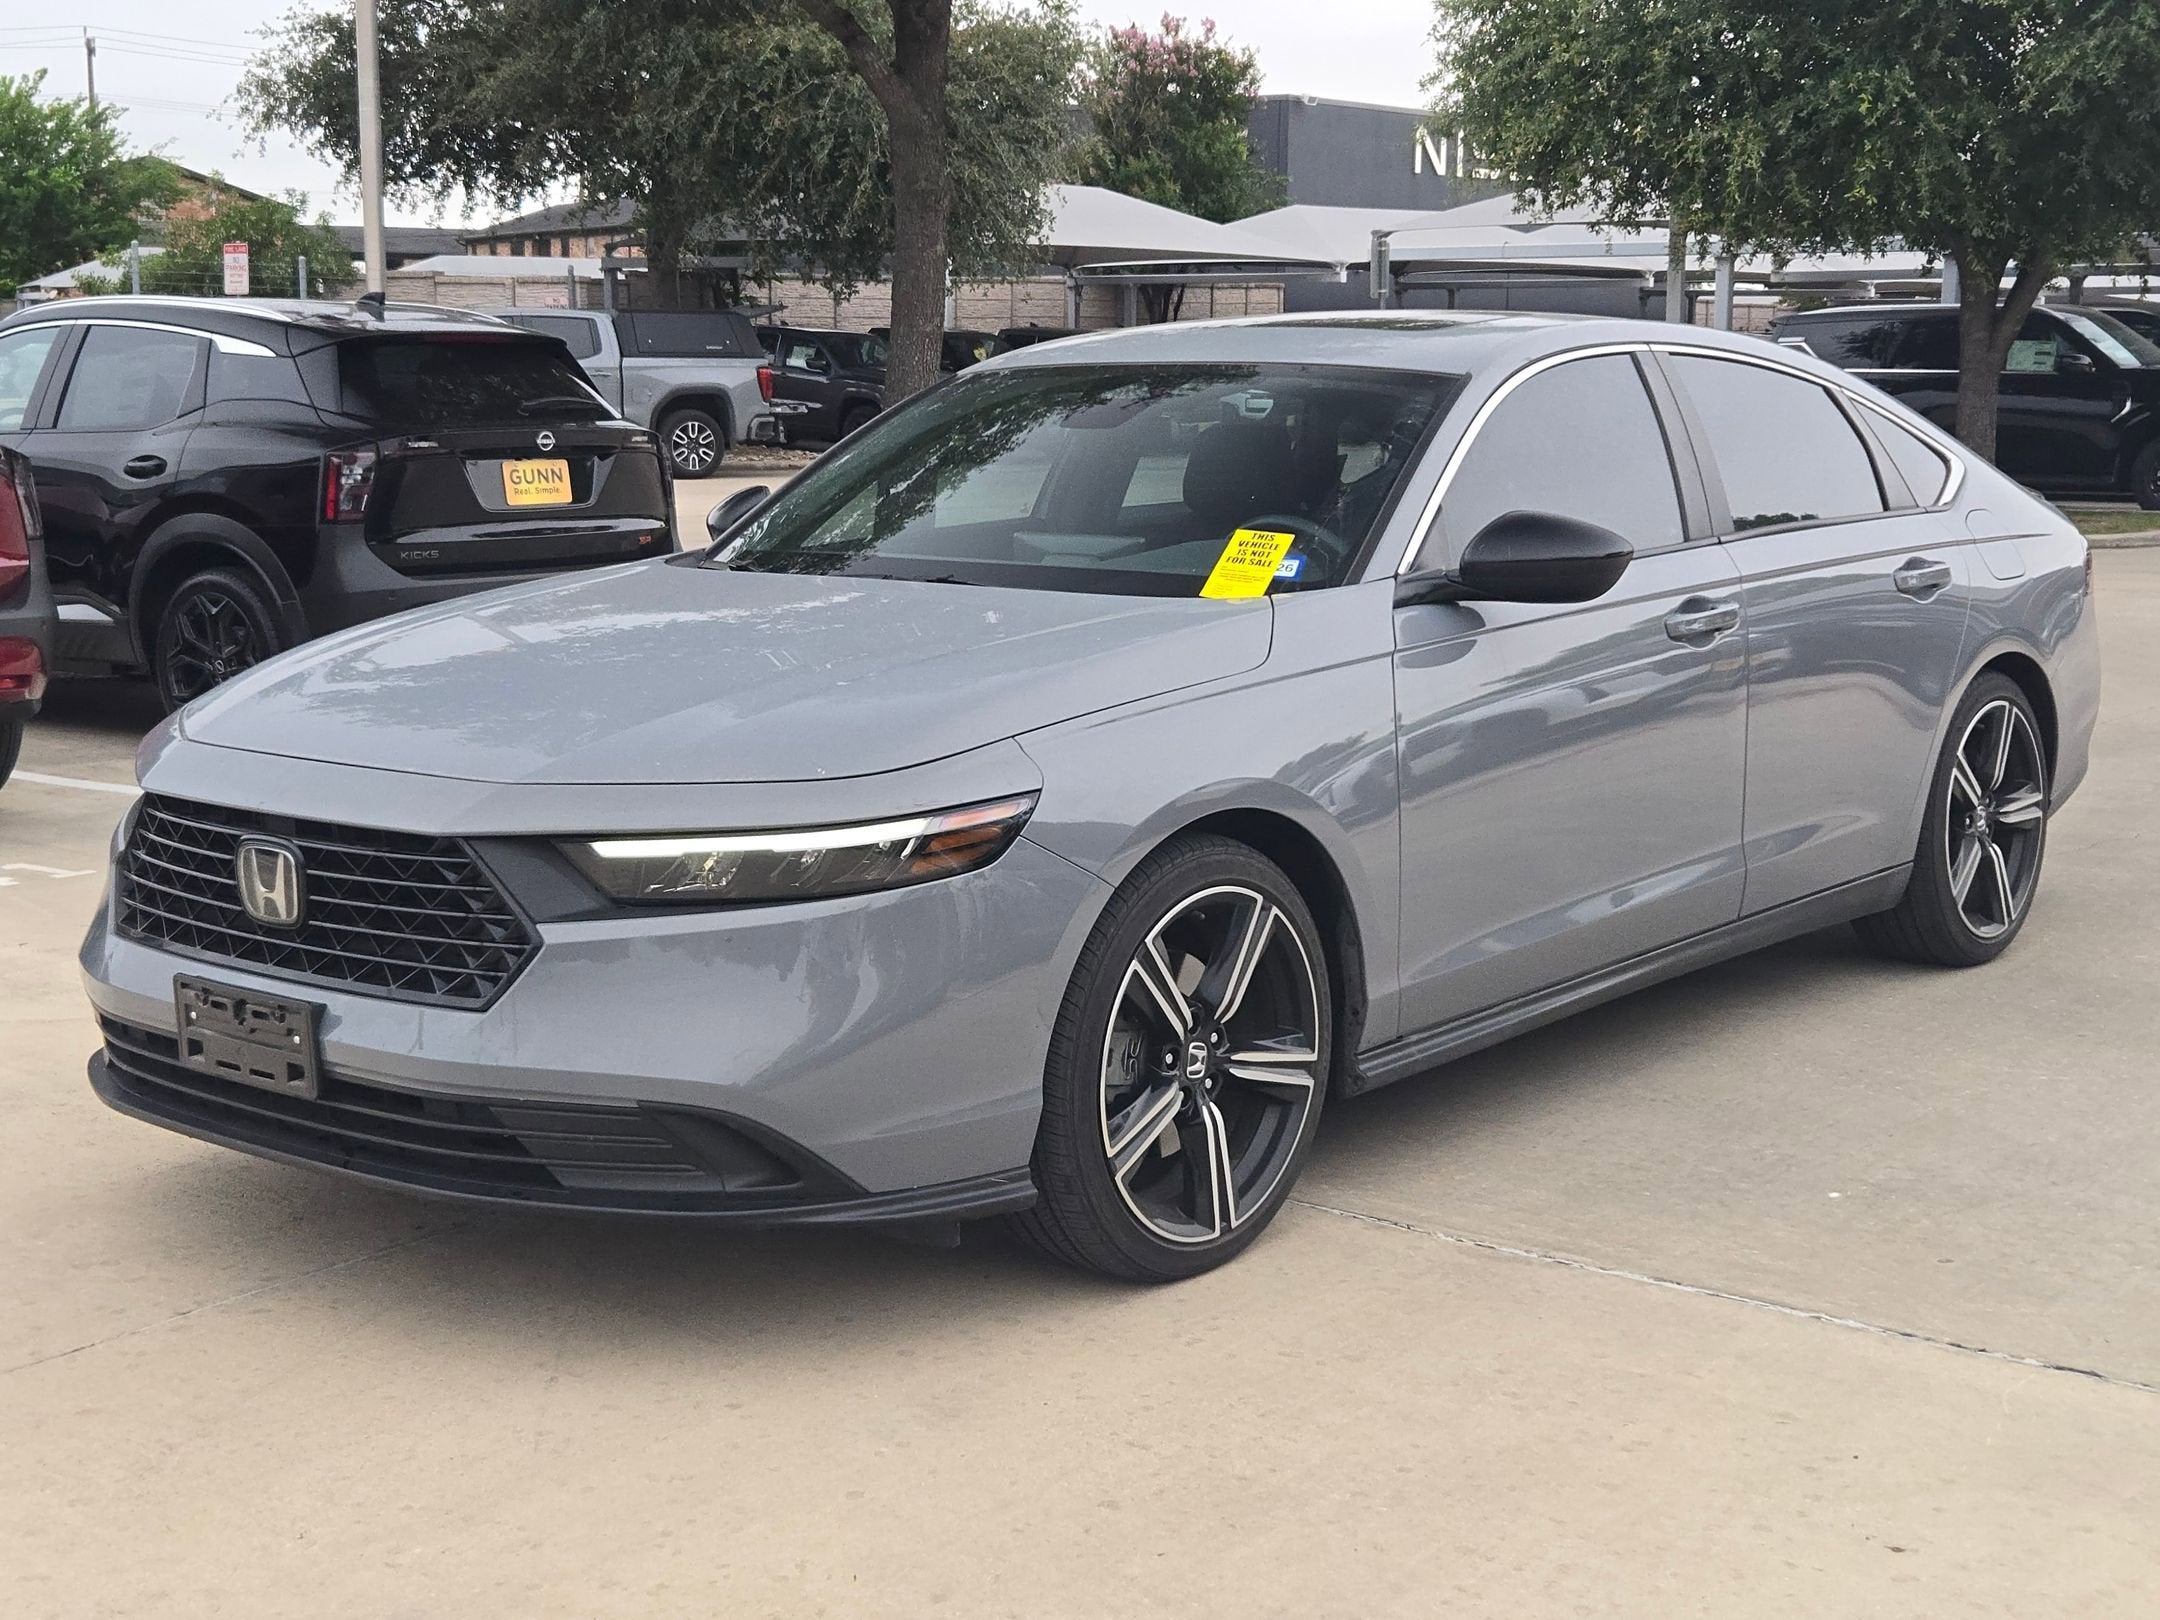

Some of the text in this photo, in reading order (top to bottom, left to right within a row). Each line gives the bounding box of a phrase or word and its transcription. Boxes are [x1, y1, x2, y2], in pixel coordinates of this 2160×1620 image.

[509, 467, 563, 485] GUNN
[513, 486, 562, 496] Real. Simple.
[1251, 532, 1276, 541] THIS
[1238, 540, 1281, 551] VEHICLE
[400, 550, 440, 560] KICKS
[1236, 548, 1272, 559] IS NOT
[1226, 556, 1274, 568] FOR SALE
[1277, 562, 1294, 573] 26
